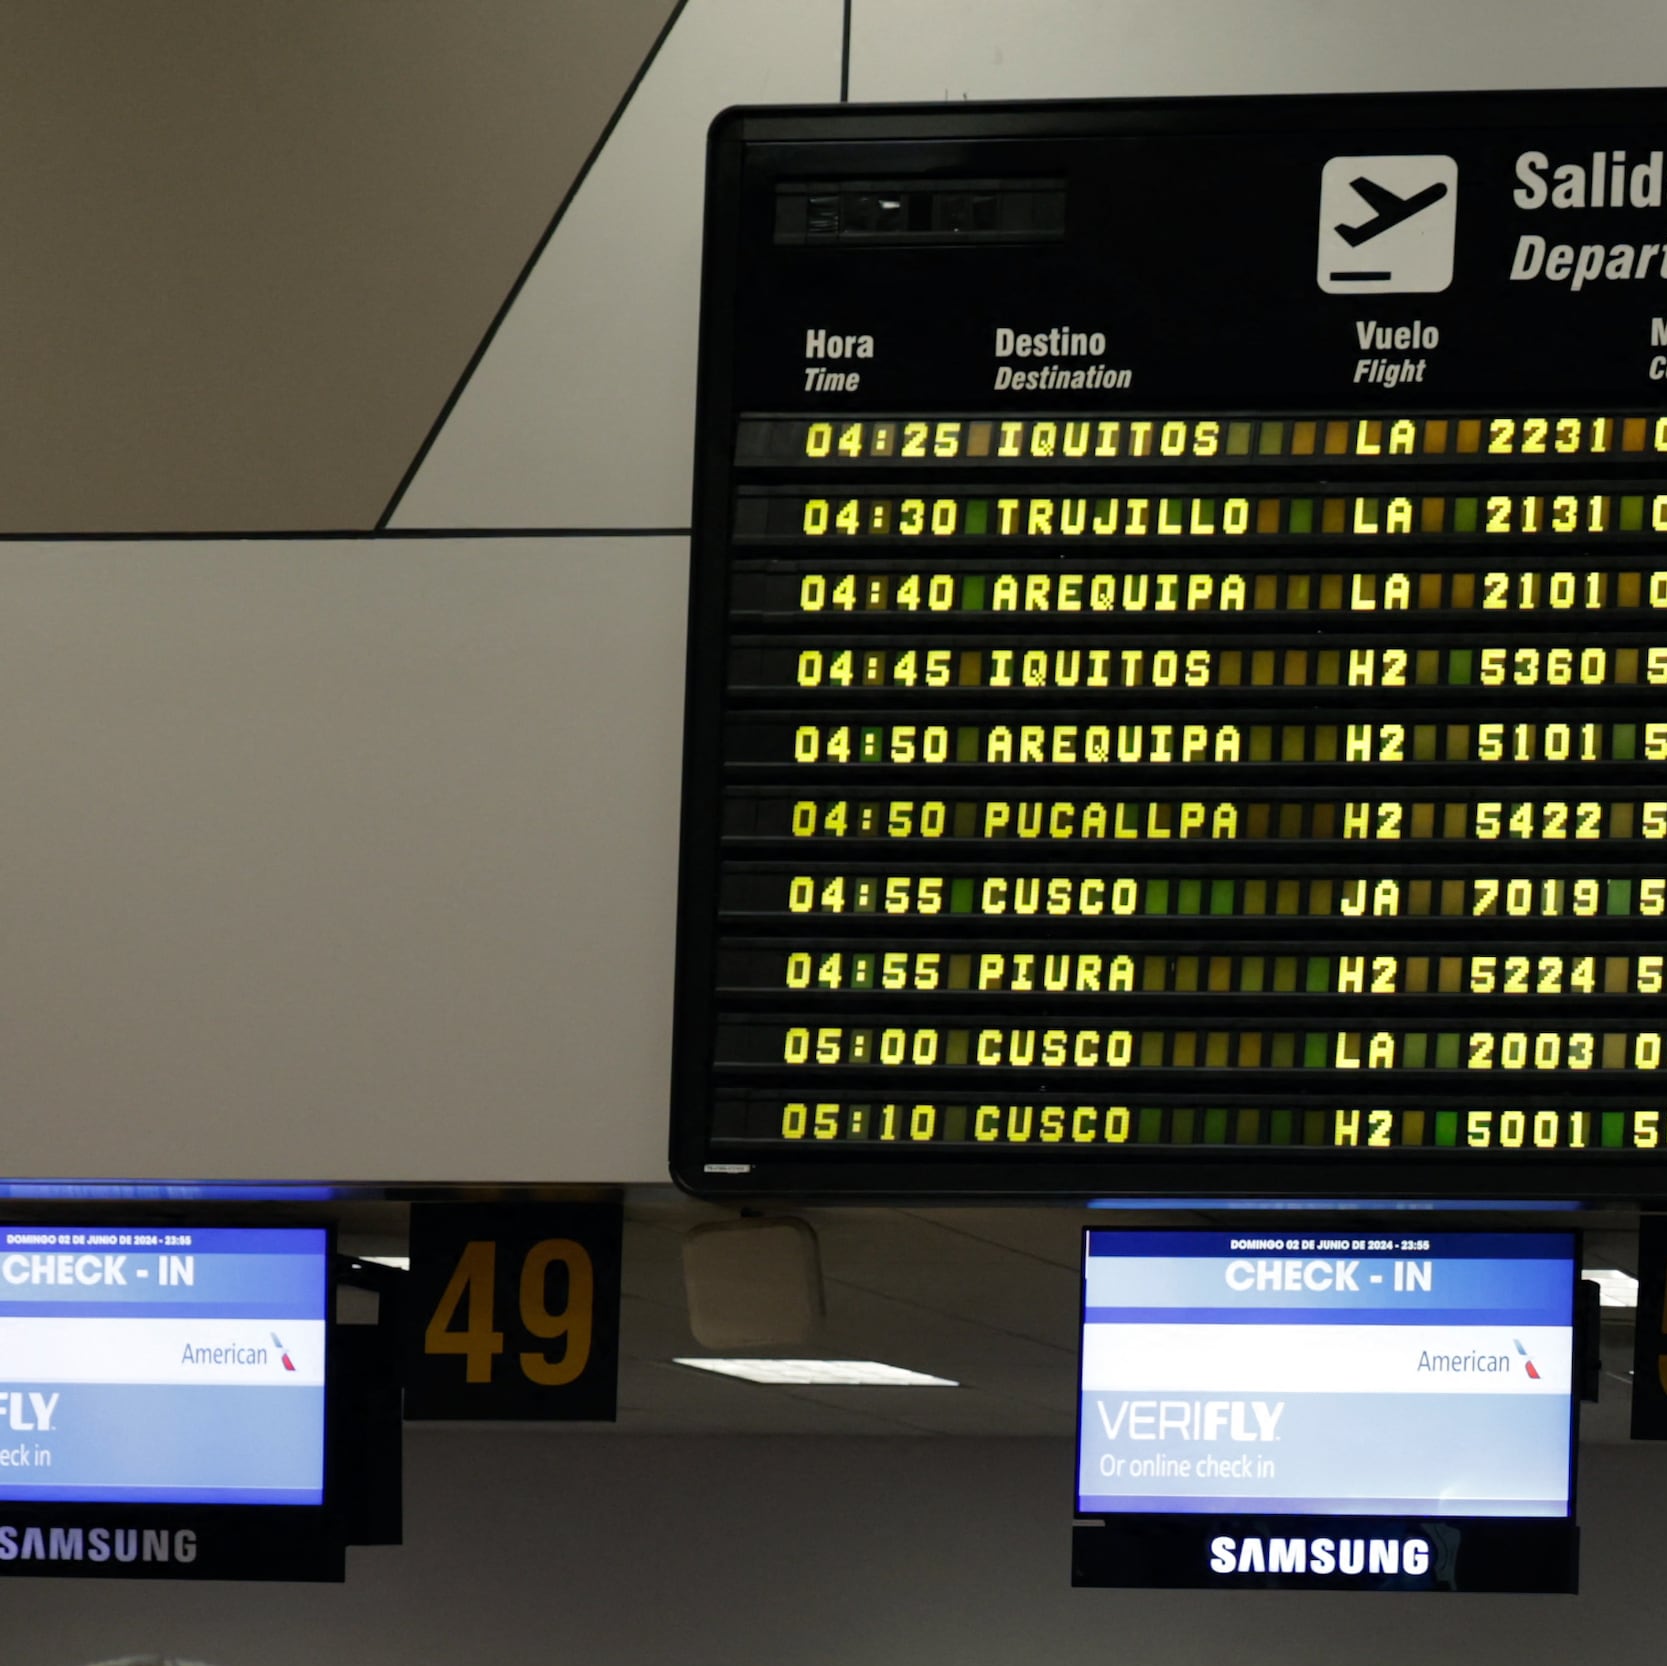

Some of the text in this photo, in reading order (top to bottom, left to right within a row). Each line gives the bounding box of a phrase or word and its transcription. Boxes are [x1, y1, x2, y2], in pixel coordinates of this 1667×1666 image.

[806, 330, 873, 358] Hora
[996, 327, 1105, 356] Destino
[1357, 321, 1438, 349] Vuelo
[805, 368, 859, 391] Time
[995, 365, 1131, 390] Destination
[1354, 359, 1426, 388] Flight
[807, 423, 960, 456] 04:25
[999, 422, 1218, 456] IQUITOS
[1357, 420, 1415, 454] LA
[1489, 419, 1605, 452] 2231
[798, 651, 950, 686] 04:45
[991, 651, 1209, 686] IQUITOS
[1349, 650, 1406, 685] H2
[1481, 649, 1605, 684] 5360
[787, 954, 939, 989] 04:55
[979, 955, 1133, 990] PIURA
[1339, 957, 1396, 992] H2
[1471, 957, 1594, 992] 5224
[1230, 1239, 1284, 1250] DOMINGO
[1286, 1240, 1300, 1250] 02
[1302, 1240, 1315, 1250] DE
[1317, 1240, 1350, 1251] JUNIO
[1352, 1240, 1366, 1251] DE
[1367, 1240, 1393, 1251] 2024
[1401, 1241, 1430, 1252] 23:55
[2, 1254, 127, 1286] CHECK
[159, 1255, 195, 1286] IN
[1225, 1260, 1359, 1292] CHECK
[1394, 1262, 1432, 1292] IN
[424, 1238, 595, 1387] 49
[182, 1342, 267, 1366] American
[1416, 1350, 1511, 1374] American
[1099, 1454, 1275, 1480] Or online check in
[0, 1526, 197, 1563] SAMSUNG
[1210, 1536, 1430, 1575] SAMSUNG
